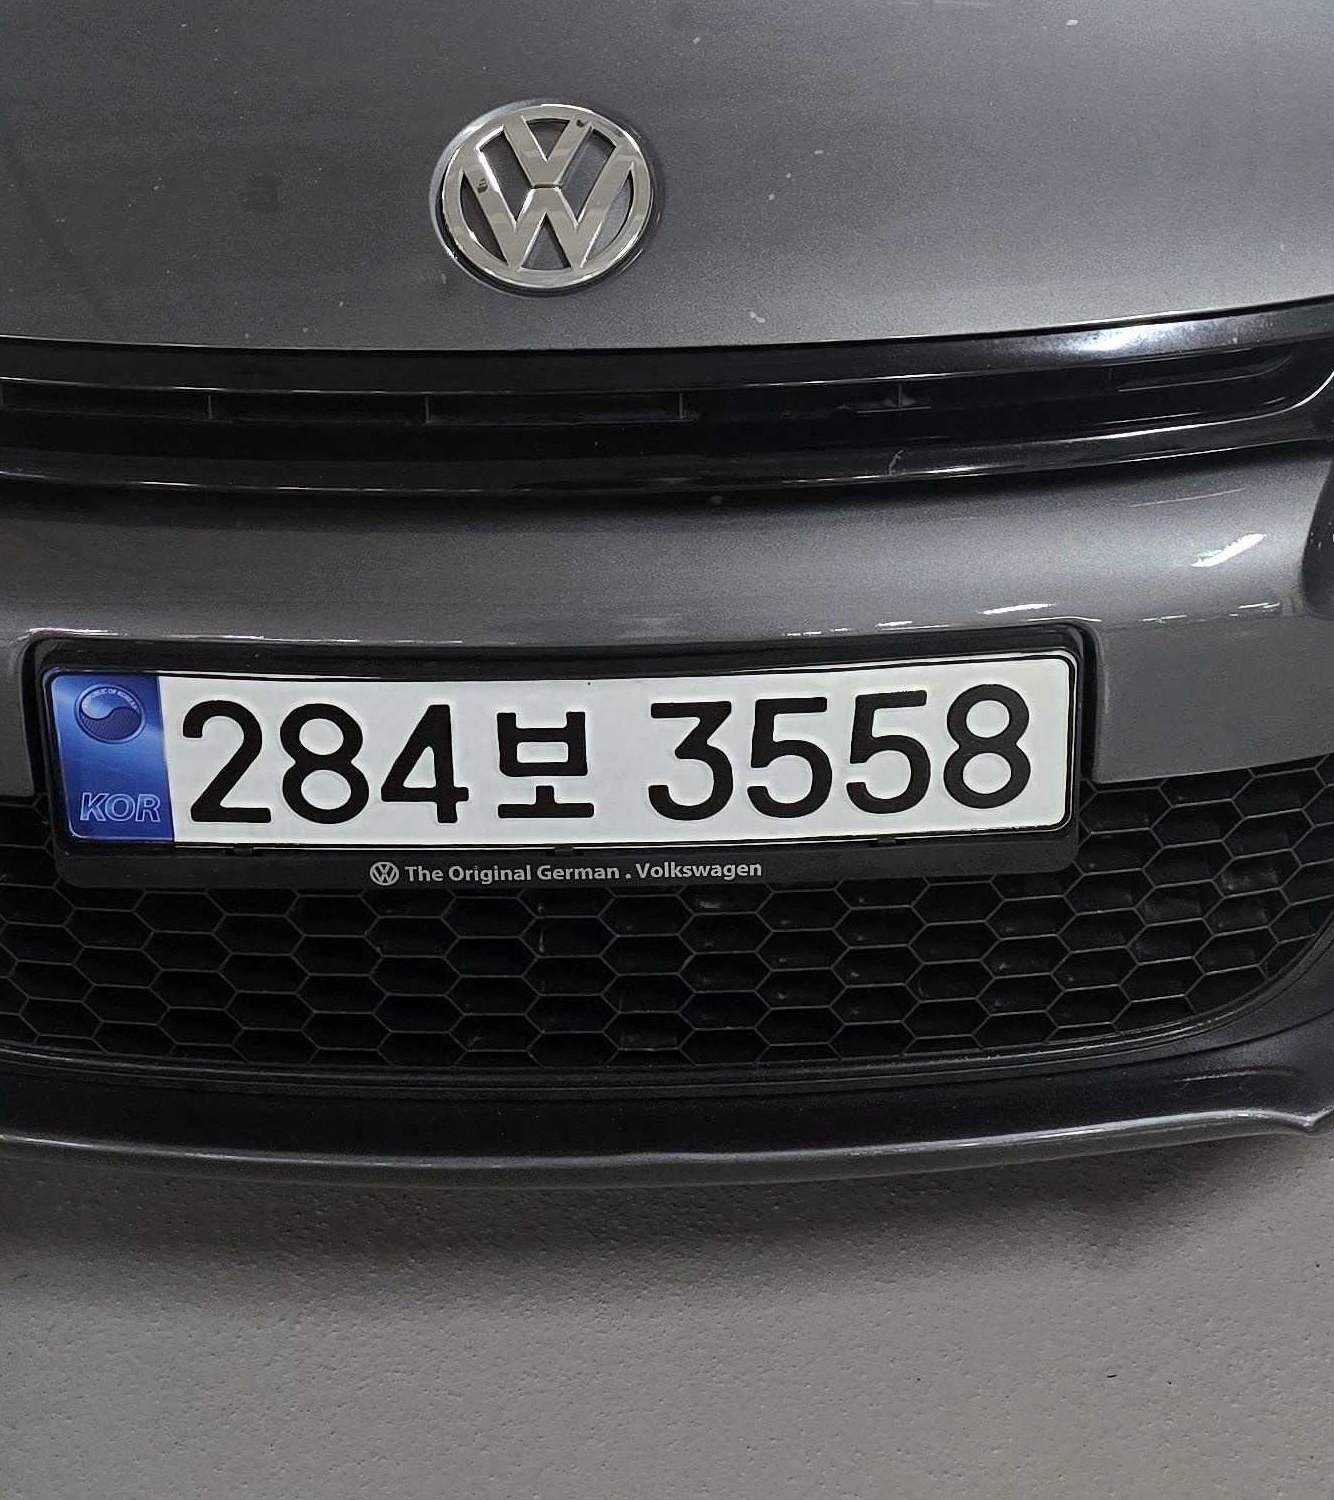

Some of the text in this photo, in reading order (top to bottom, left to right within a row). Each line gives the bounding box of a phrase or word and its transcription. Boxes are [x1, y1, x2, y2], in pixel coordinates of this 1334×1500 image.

[182, 684, 1030, 825] 284보 3558
[79, 792, 161, 823] KOR
[404, 865, 444, 882] The
[448, 865, 532, 885] Original
[536, 864, 620, 880] German
[635, 861, 763, 881] Volkswagen
